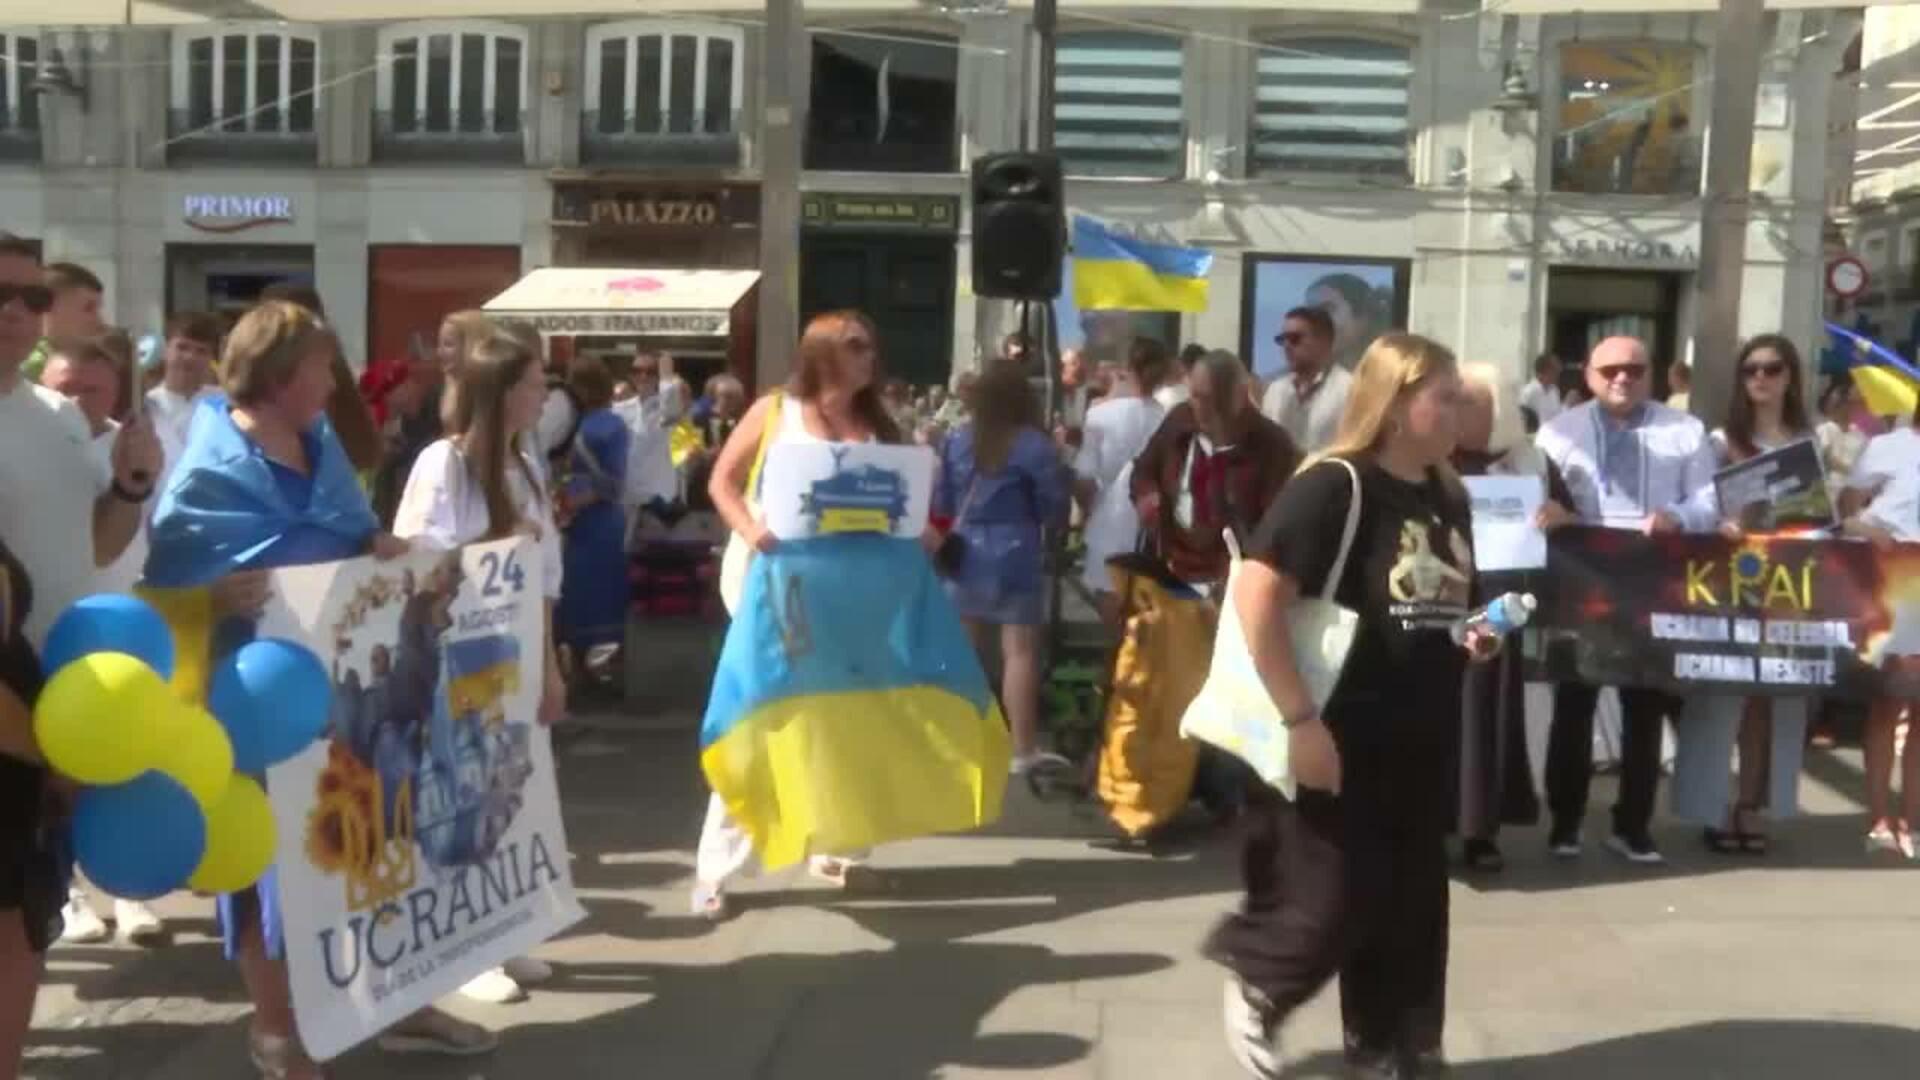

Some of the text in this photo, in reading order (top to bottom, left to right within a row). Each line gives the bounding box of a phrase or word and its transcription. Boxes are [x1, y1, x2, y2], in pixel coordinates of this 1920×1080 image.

[183, 193, 291, 217] PRIMOR
[590, 202, 716, 224] PALAZZO
[603, 314, 719, 332] ITALIANOS
[479, 548, 524, 597] 24
[318, 832, 561, 988] UCRANIA
